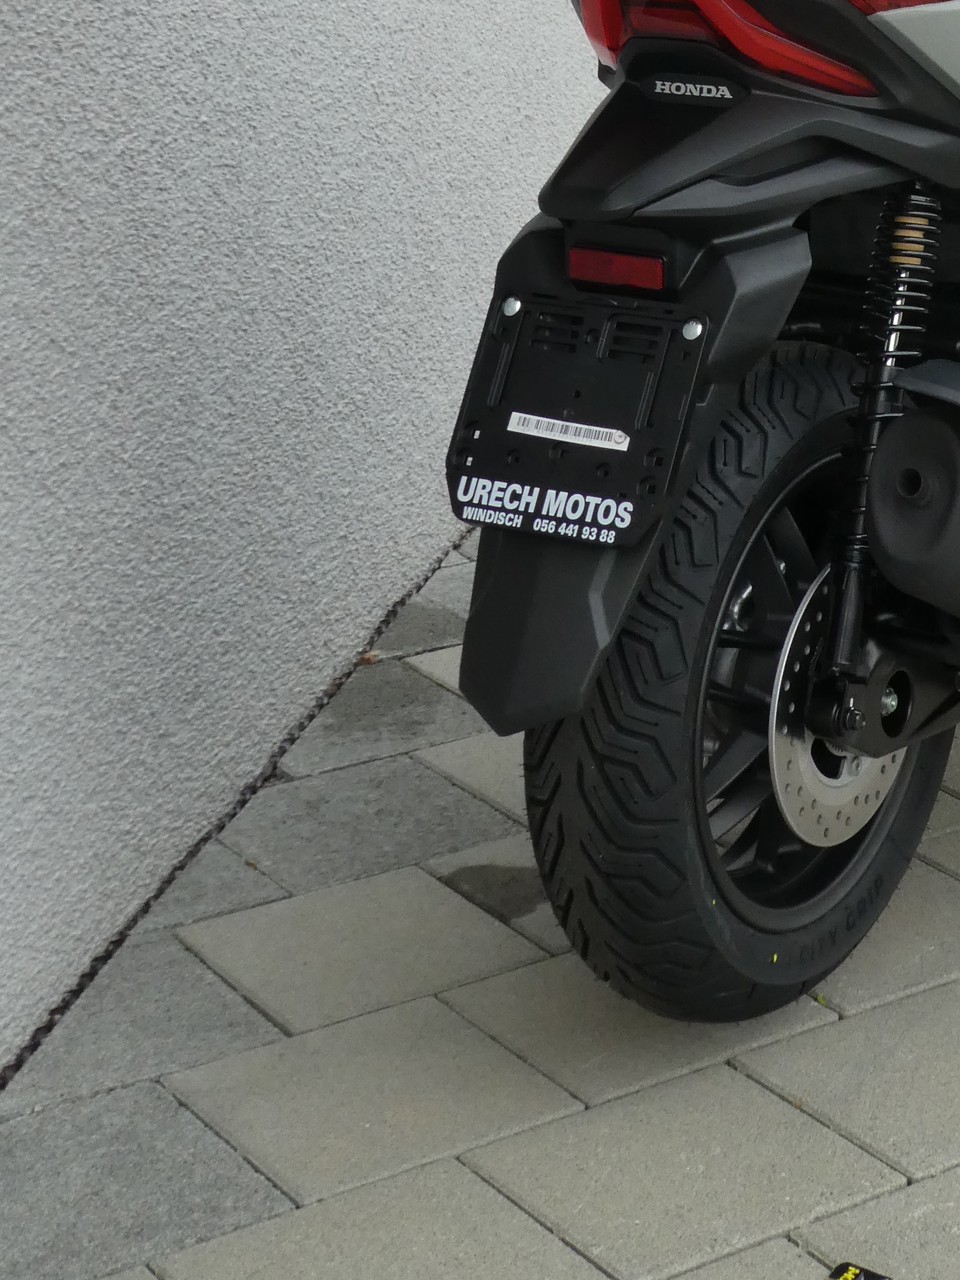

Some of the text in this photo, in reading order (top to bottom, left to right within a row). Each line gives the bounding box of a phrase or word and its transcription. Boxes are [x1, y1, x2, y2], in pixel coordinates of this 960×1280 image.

[654, 80, 733, 99] HONDA
[456, 475, 634, 529] URECH MOTOS
[462, 505, 616, 544] WINDISCH 056 441 93 88
